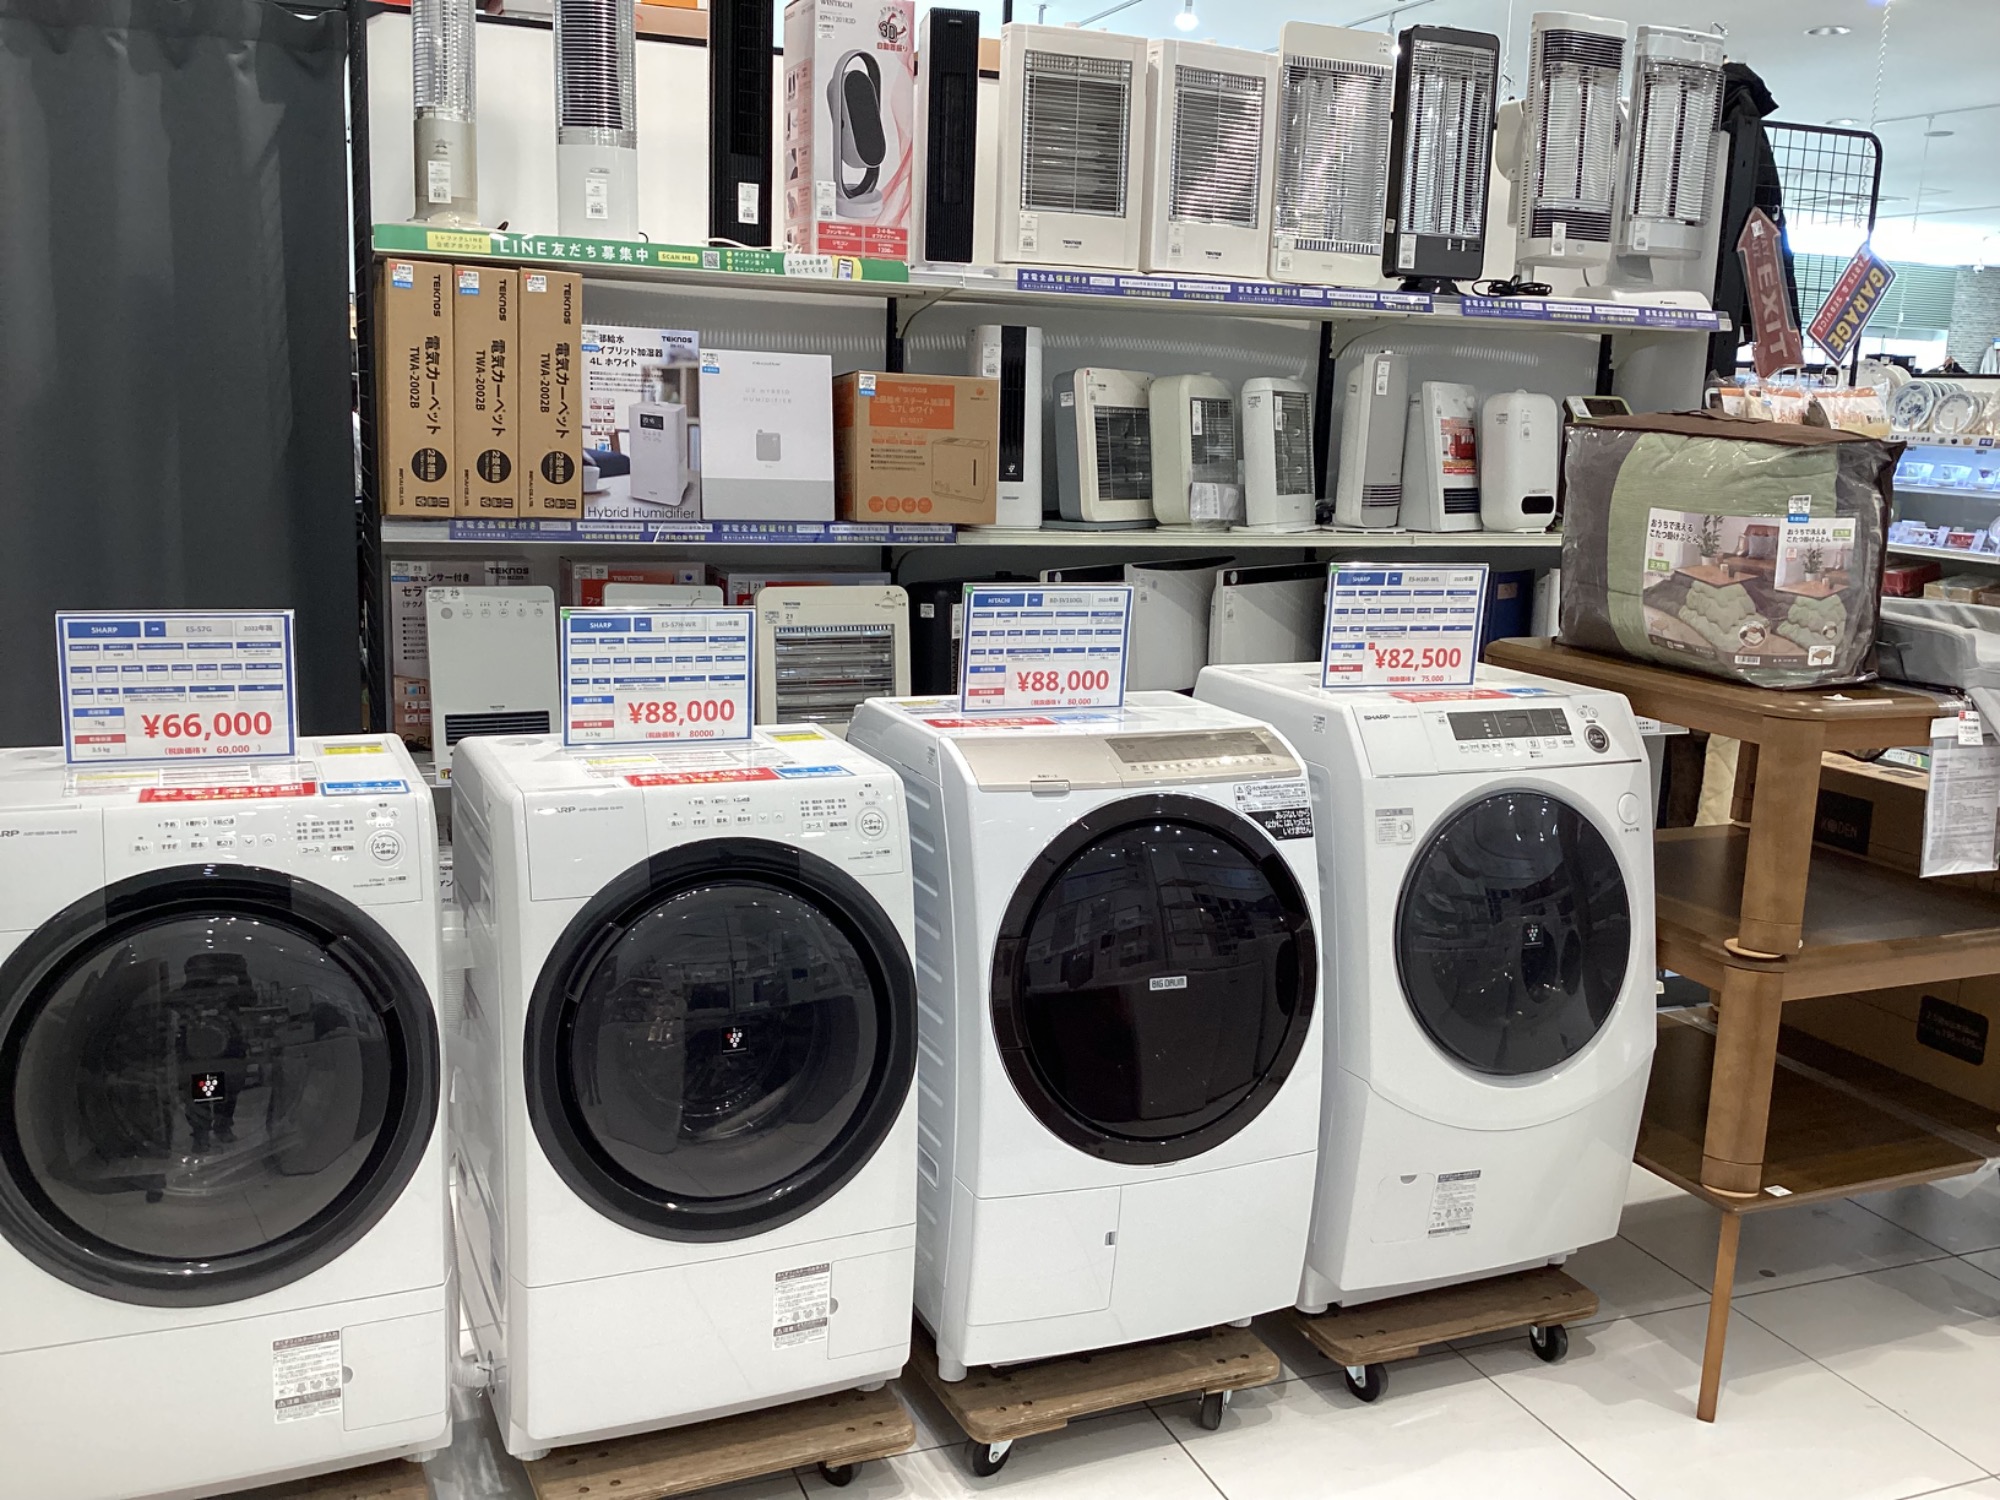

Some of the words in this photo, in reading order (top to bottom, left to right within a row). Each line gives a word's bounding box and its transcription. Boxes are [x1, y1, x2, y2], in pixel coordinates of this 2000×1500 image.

[879, 21, 898, 43] 3D
[499, 239, 650, 262] LINE友だち募集中
[1022, 272, 1088, 285] 家電全品保証付き
[433, 274, 441, 317] TEKNOS
[498, 279, 507, 321] TEKNOS
[563, 283, 572, 325] TEKNOS
[1757, 262, 1788, 358] EXIT
[1816, 295, 1843, 333] SERVICE
[1827, 267, 1885, 352] GARAGE
[661, 335, 693, 344] TEKNOS
[590, 357, 602, 366] 4L
[605, 358, 637, 368] ホワイト
[597, 345, 663, 358] イブリッド加湿器
[409, 347, 420, 409] TWA-2002B
[424, 335, 441, 435] 電気カーペット
[475, 350, 486, 411] TWA-2002B
[490, 339, 506, 437] 電気カーペット
[540, 352, 550, 413] TWA-2002B
[555, 342, 570, 439] 電気カーペット
[587, 506, 630, 520] Hybrid
[633, 507, 696, 520] Humidifier
[455, 520, 537, 531] 家電全品保証付き
[722, 524, 794, 533] 家電全品保証付き
[1650, 519, 1694, 533] おうちで洗える
[1650, 529, 1701, 545] こたつ掛けふとん
[489, 567, 529, 575] TEKNOS
[402, 586, 428, 597] セラ
[91, 626, 118, 634] SHARP
[1375, 648, 1462, 671] ¥82,500
[1016, 669, 1110, 694] ¥88,000
[628, 699, 735, 726] ¥88,000
[1364, 713, 1391, 721] SHARP
[141, 711, 273, 741] ¥66,000
[689, 729, 714, 738] 80000
[216, 744, 250, 755] 60,000
[375, 842, 396, 850] スタート
[1152, 979, 1164, 988] BIG
